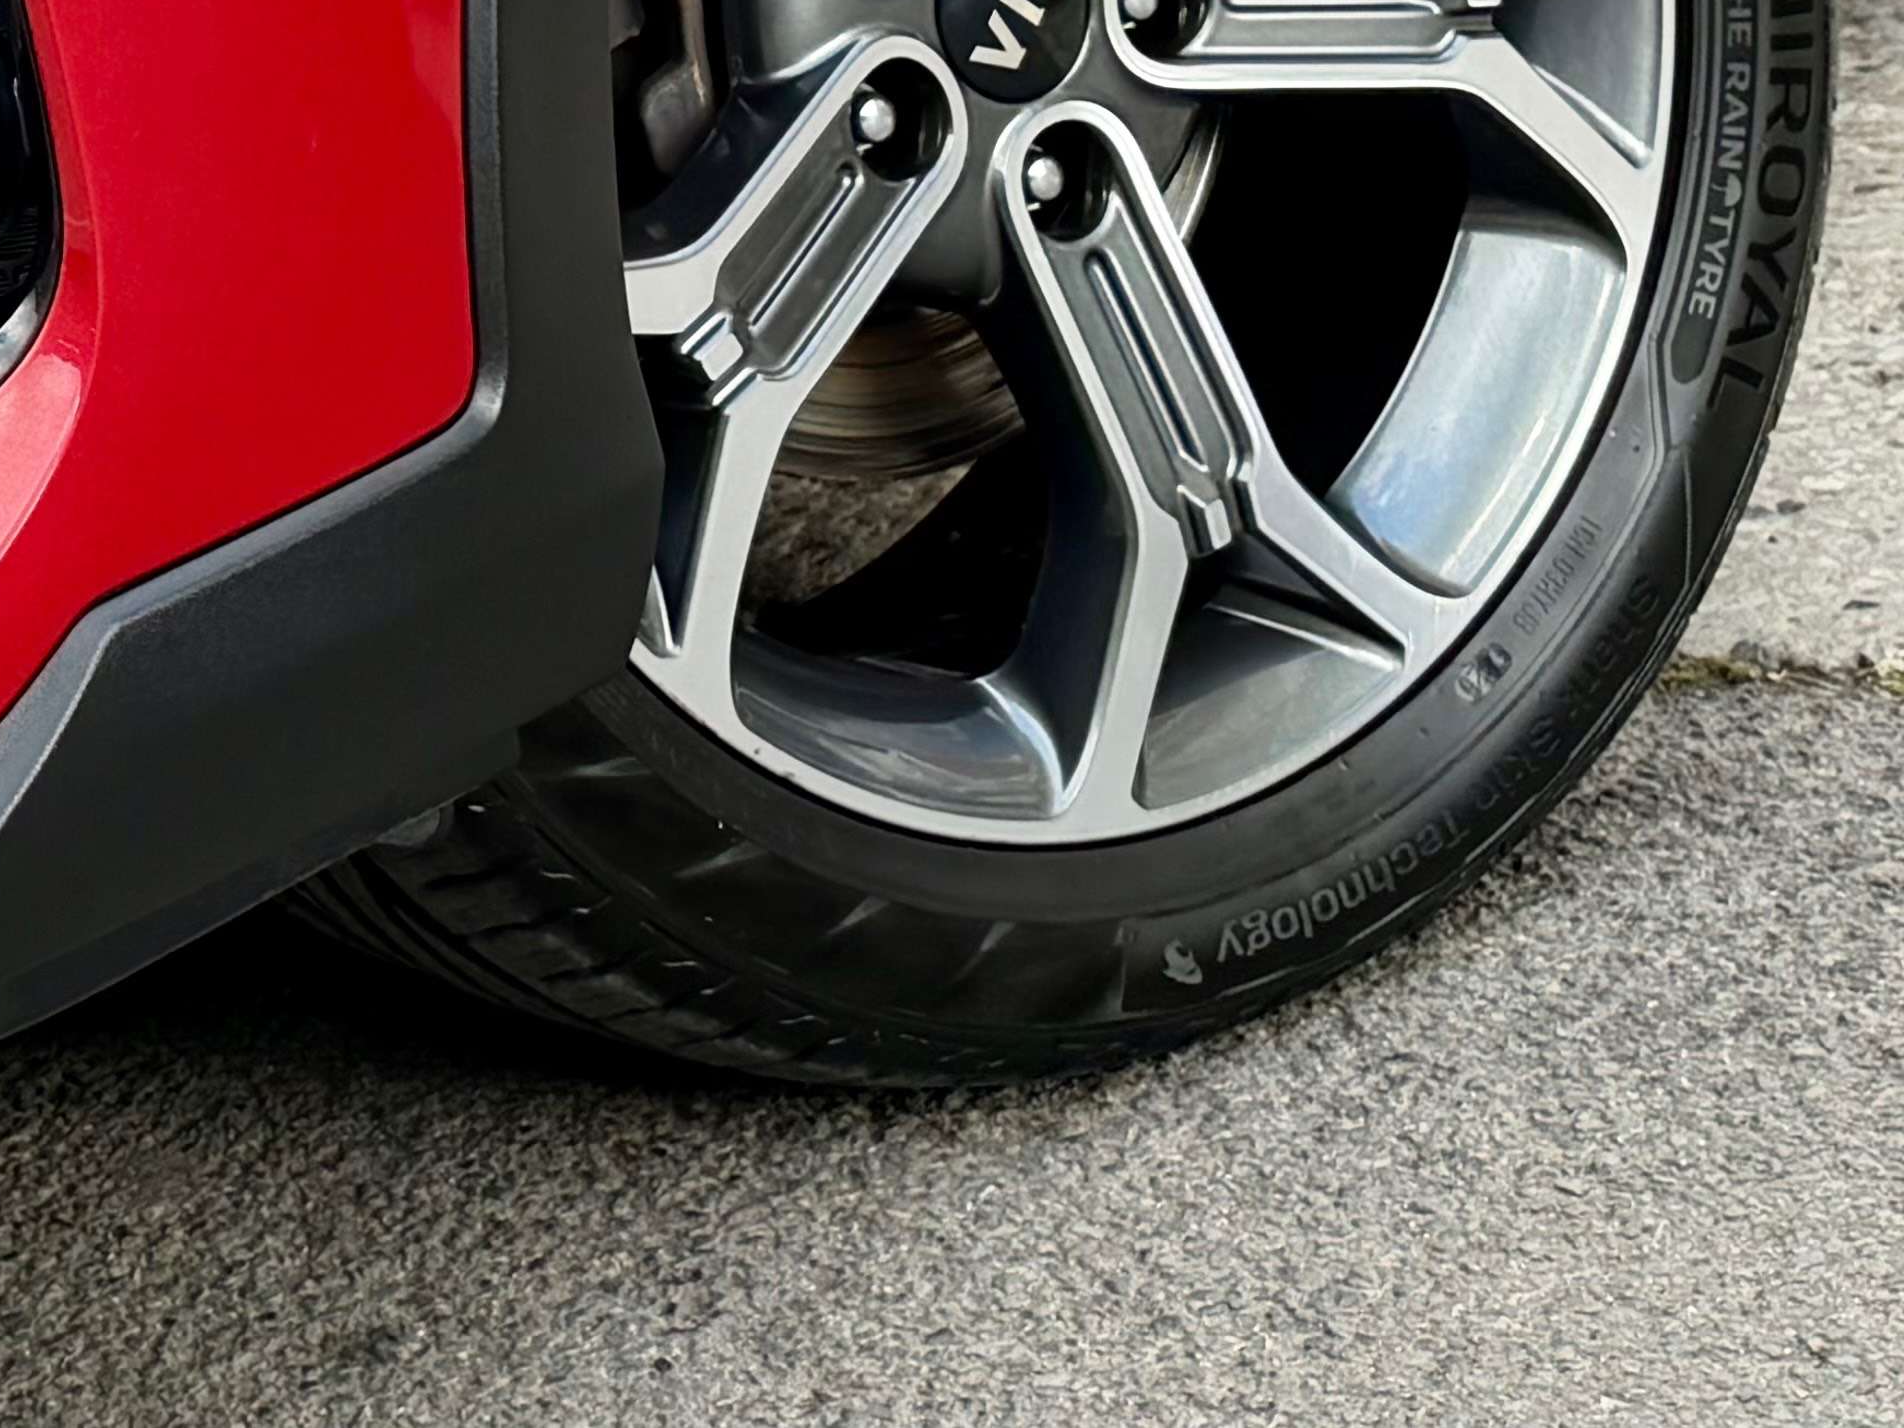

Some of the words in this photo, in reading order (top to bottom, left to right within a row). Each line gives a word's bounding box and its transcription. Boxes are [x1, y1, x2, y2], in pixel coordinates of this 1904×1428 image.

[1716, 57, 1750, 170] RAIN
[1685, 208, 1738, 322] TYRE
[1214, 808, 1473, 964] Technology
